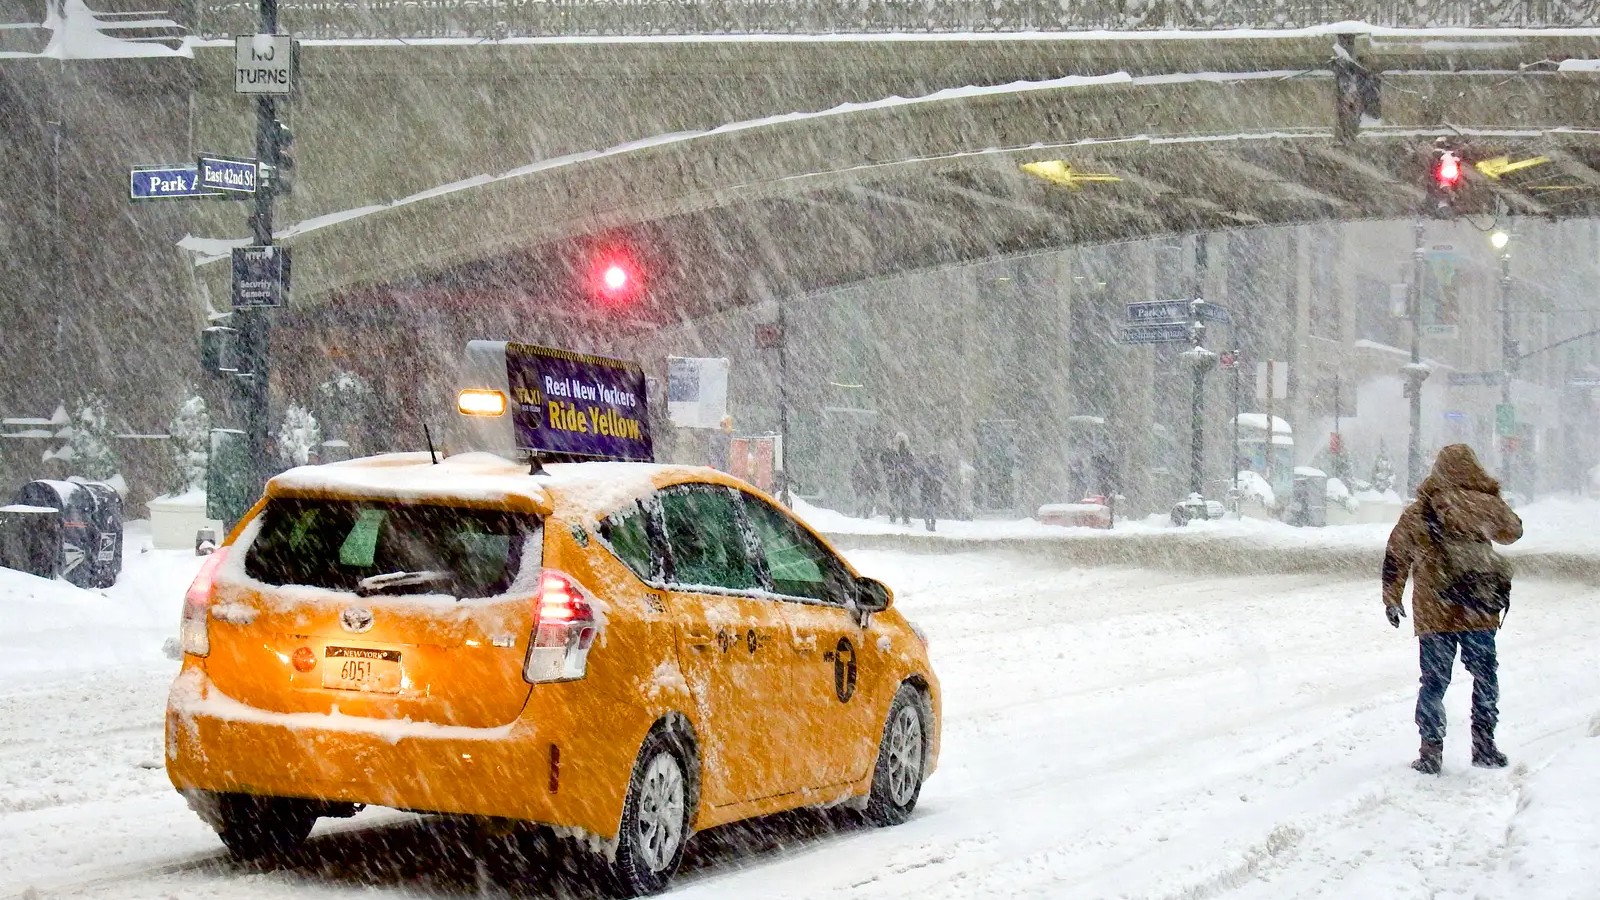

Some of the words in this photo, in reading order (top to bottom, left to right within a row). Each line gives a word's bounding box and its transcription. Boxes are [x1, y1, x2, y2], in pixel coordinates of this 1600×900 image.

[251, 45, 275, 61] NO
[238, 69, 287, 84] TURNS
[150, 175, 187, 192] Park
[204, 165, 223, 183] East
[224, 168, 243, 186] 42nd
[244, 171, 254, 187] St
[240, 280, 271, 289] Security
[240, 289, 270, 298] Camera
[516, 387, 541, 406] TAXI
[545, 375, 571, 398] Real
[572, 379, 596, 401] New
[597, 383, 636, 408] Yorkers
[548, 400, 587, 434] Ride
[343, 650, 362, 658] NEW
[363, 651, 382, 659] YORK
